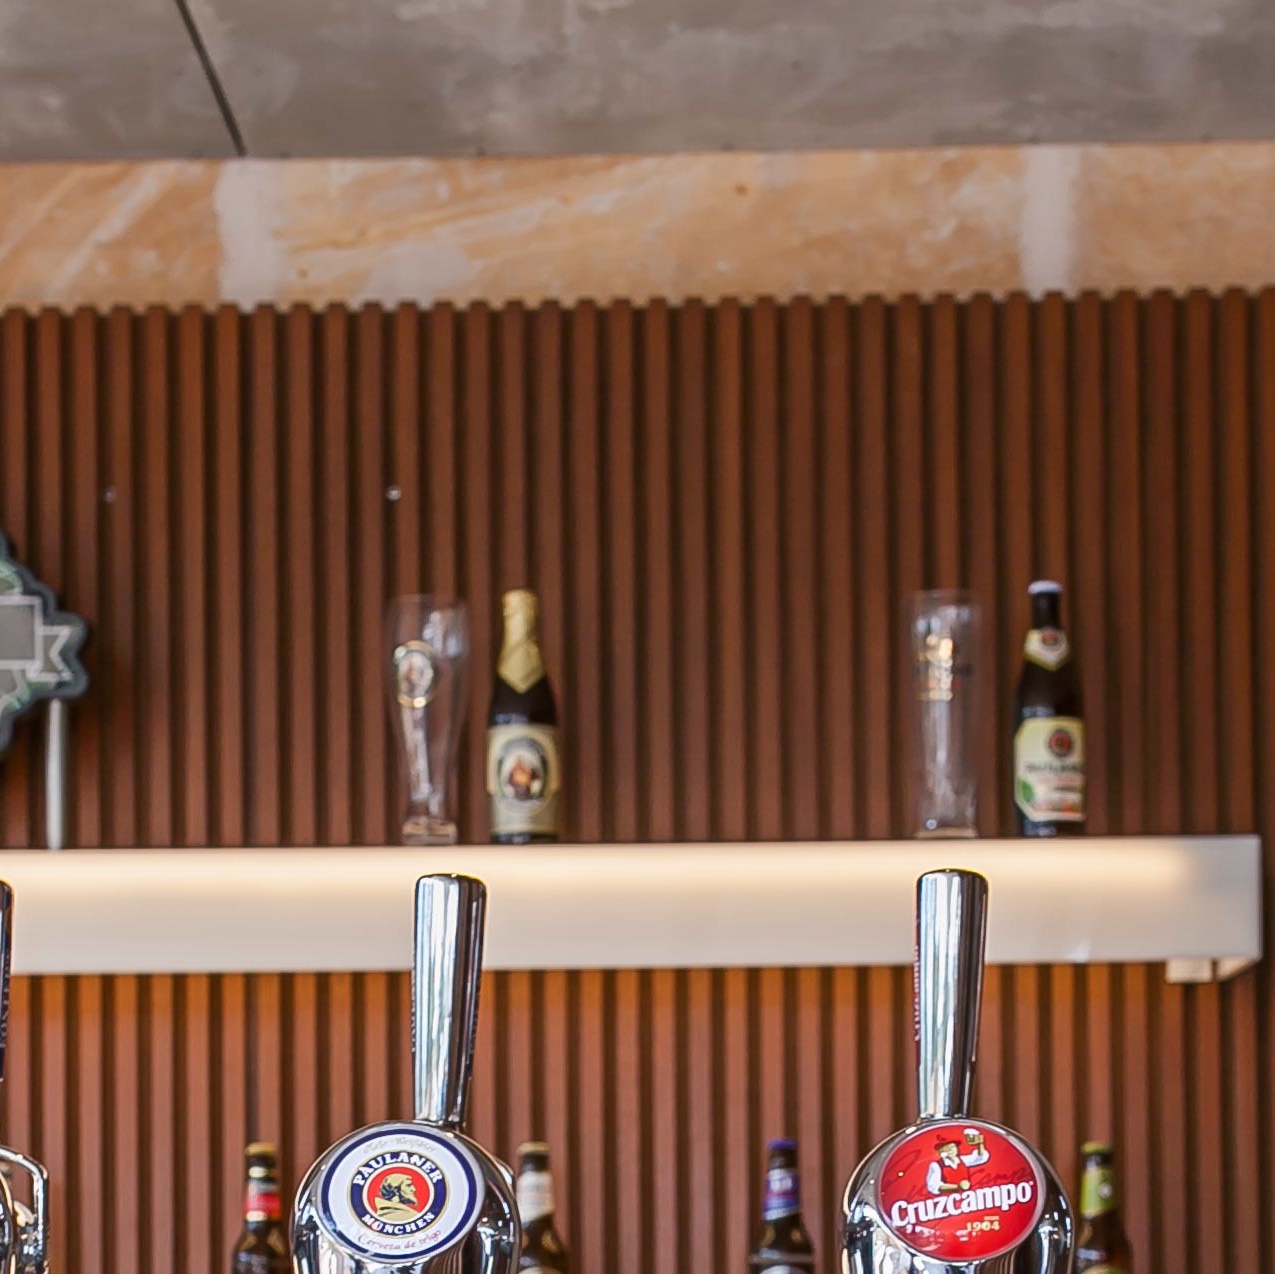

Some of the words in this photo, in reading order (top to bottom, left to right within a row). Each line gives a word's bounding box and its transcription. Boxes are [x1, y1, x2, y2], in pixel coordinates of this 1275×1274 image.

[352, 1152, 443, 1187] PAULANER
[890, 1181, 1032, 1228] Cruzcampo
[966, 1221, 1000, 1232] 1904
